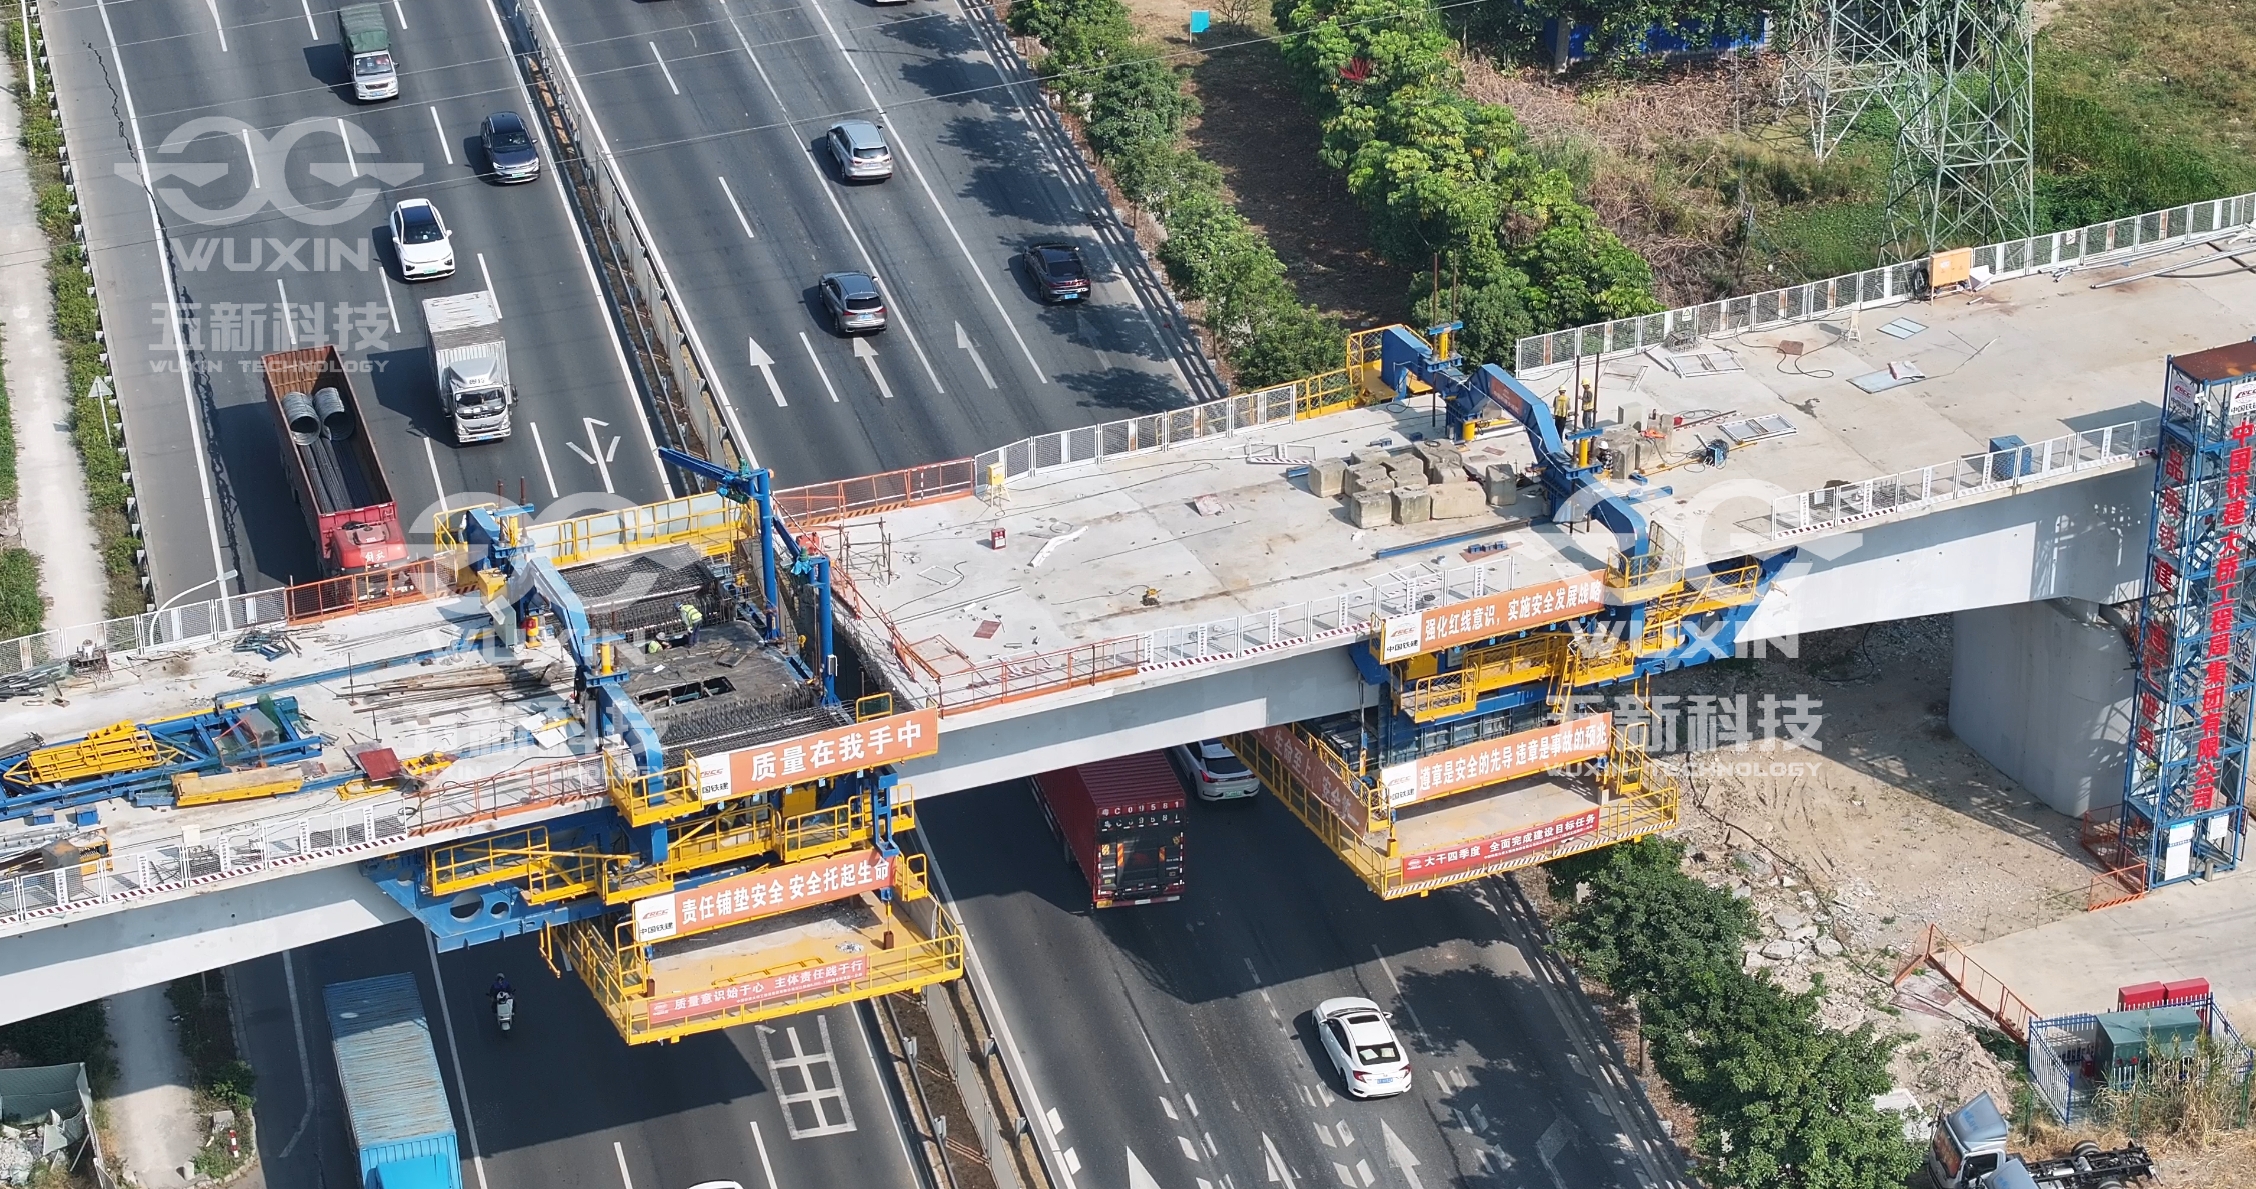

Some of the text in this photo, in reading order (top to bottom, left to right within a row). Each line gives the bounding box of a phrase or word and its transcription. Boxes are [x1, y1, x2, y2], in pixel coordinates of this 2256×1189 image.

[2192, 420, 2256, 811] 中国铁建大桥工程局集团有限公司
[1386, 639, 1419, 653] 中国铁建
[751, 719, 922, 782] 质量在我手中
[1419, 721, 1608, 792] 遵章是安全的先导 违章是事故的预兆
[1424, 845, 1481, 868] 大干四季度
[1489, 813, 1596, 853] 全面完成建设目标任务
[681, 857, 890, 925] 责任铺垫安全 安全托起生命
[639, 922, 674, 935] 中国铁建
[674, 982, 765, 1011] 质量意识始于心
[774, 959, 863, 989] 主体责任践于行
